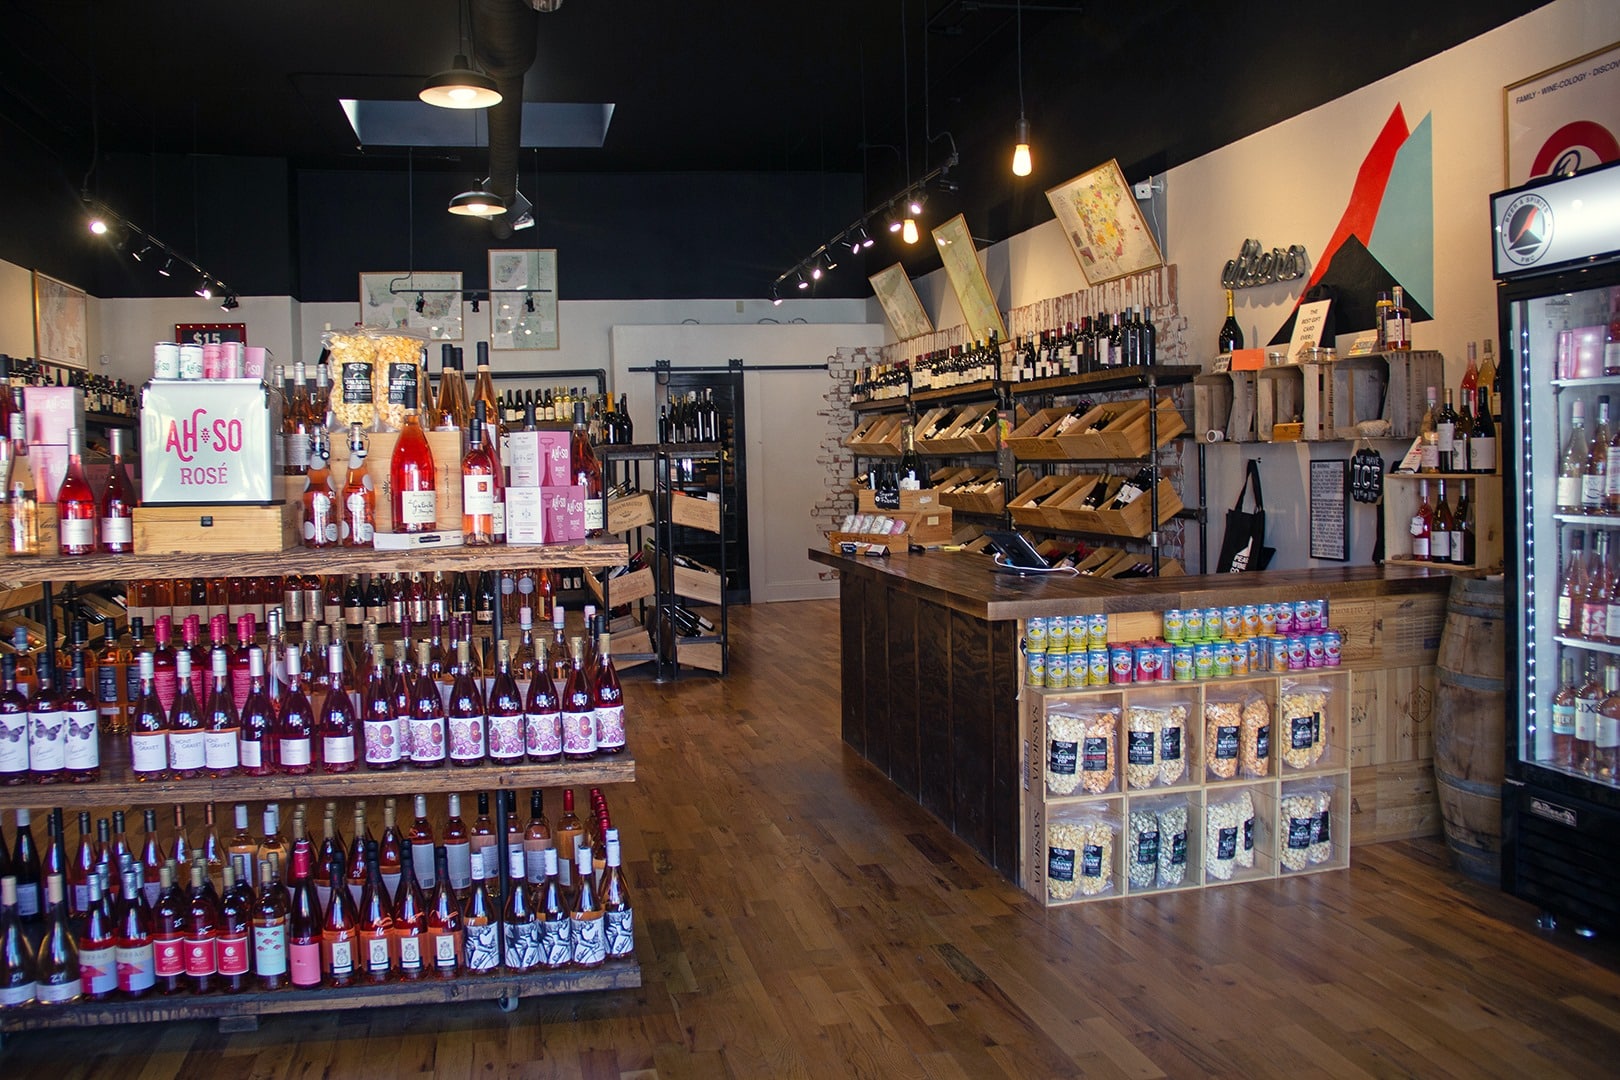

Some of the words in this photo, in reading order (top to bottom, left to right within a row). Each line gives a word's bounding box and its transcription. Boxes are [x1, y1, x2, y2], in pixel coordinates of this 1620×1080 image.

[1516, 91, 1537, 104] FAMILY
[193, 332, 221, 345] $15
[180, 462, 228, 485] ROSÉ
[1353, 465, 1380, 489] ICE
